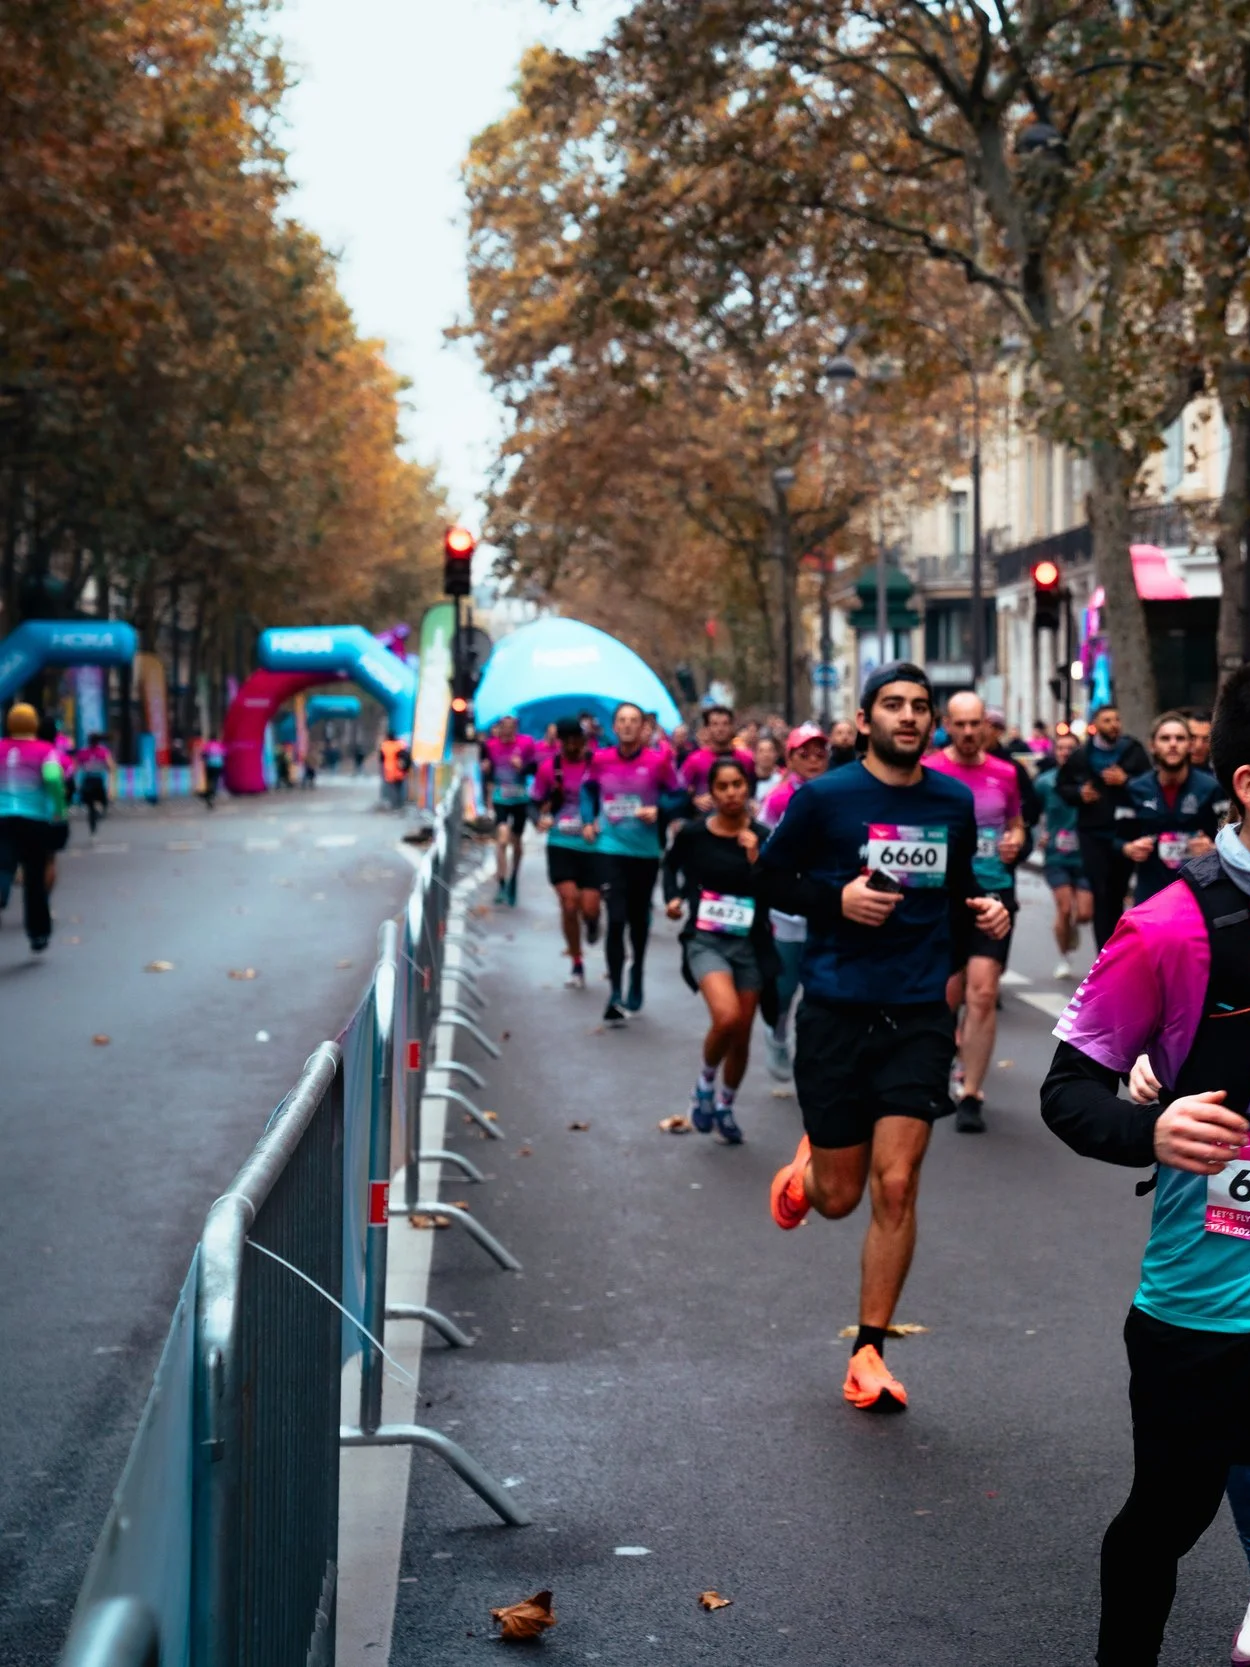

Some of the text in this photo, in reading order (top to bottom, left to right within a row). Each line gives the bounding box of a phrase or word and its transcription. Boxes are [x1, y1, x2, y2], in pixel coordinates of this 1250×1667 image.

[880, 846, 937, 867] 6660
[1211, 1209, 1235, 1220] LET'S
[1236, 1213, 1250, 1222] FLY
